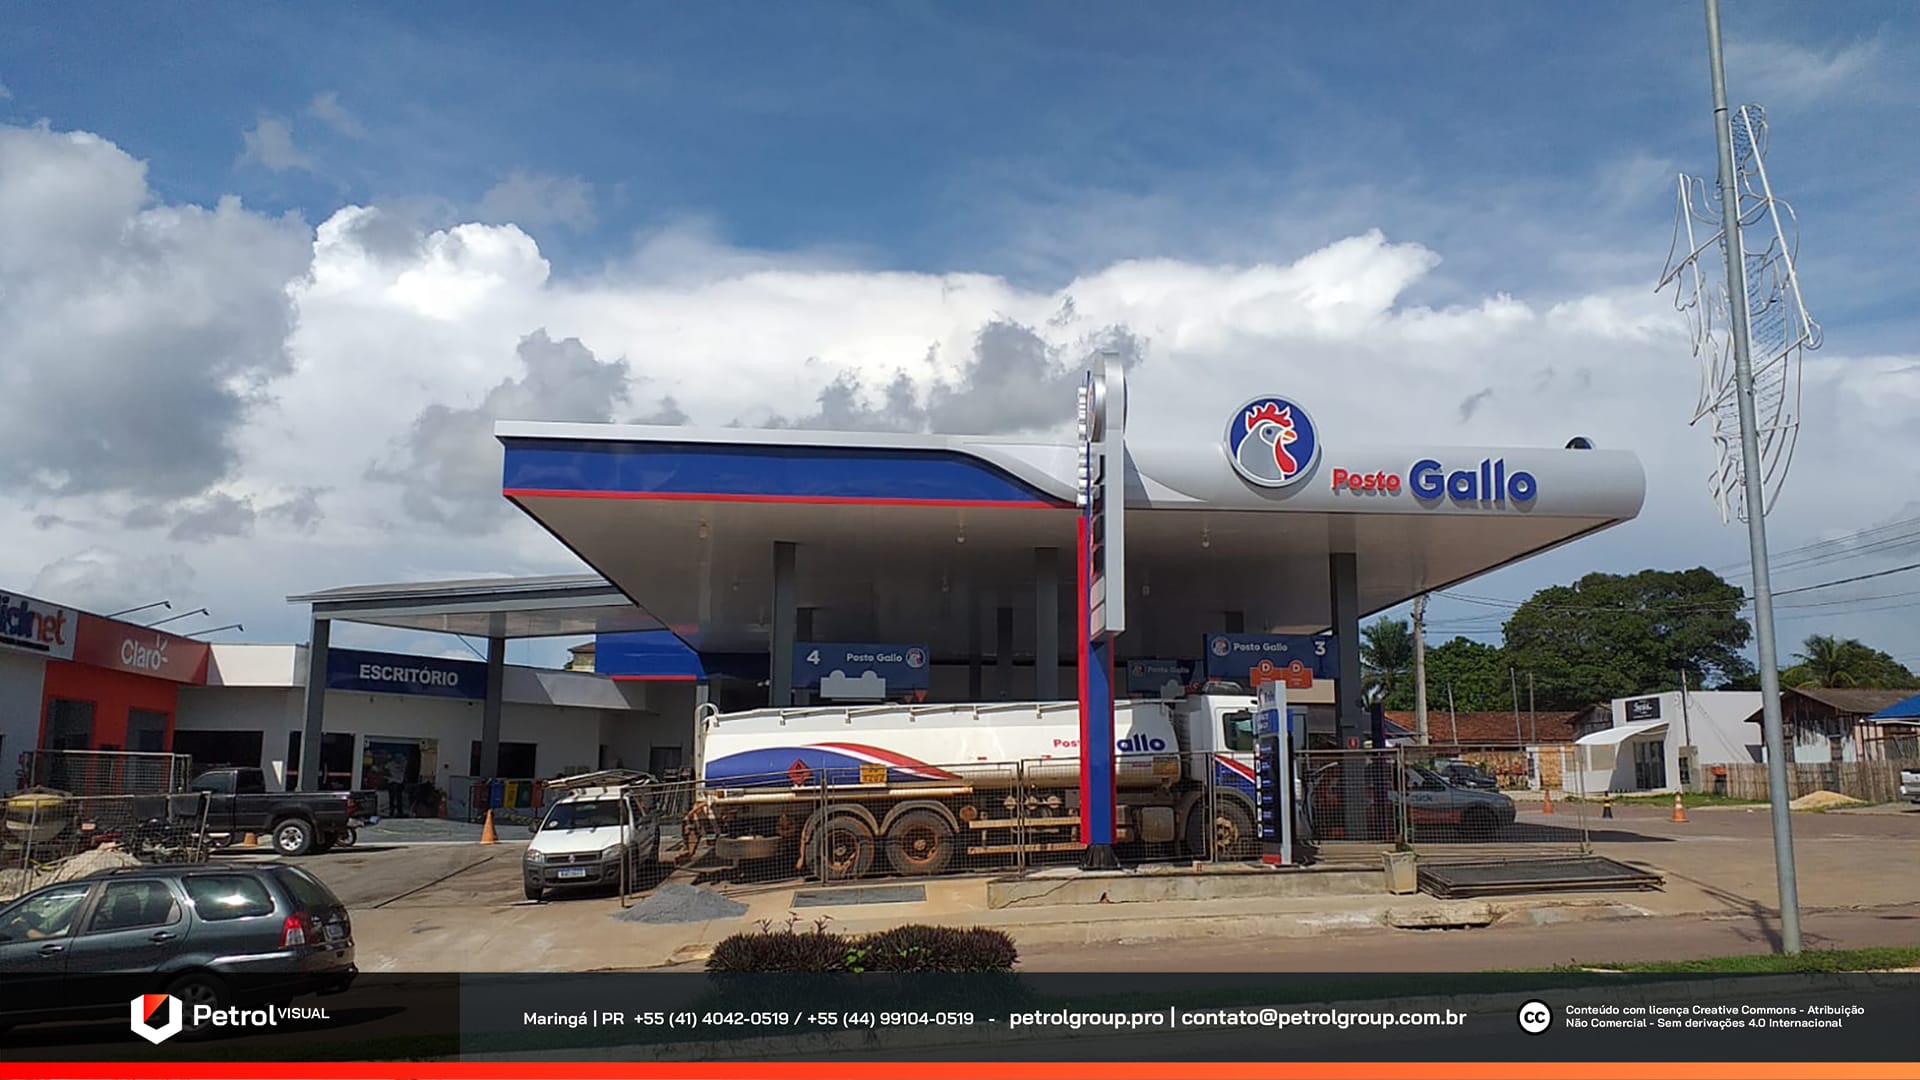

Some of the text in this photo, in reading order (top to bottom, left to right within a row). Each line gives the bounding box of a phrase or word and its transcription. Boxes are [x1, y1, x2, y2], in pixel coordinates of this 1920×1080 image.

[1332, 458, 1537, 502] Posto Gallo
[121, 638, 162, 670] Claro
[1233, 642, 1288, 652] Posto Gallo
[1314, 640, 1326, 655] 3
[806, 650, 821, 665] 4
[846, 653, 903, 663] Posto Gallo
[1262, 662, 1271, 672] D
[1292, 663, 1301, 673] D
[359, 664, 458, 686] ESCRITÓRIO
[1053, 733, 1166, 752] Pos allo
